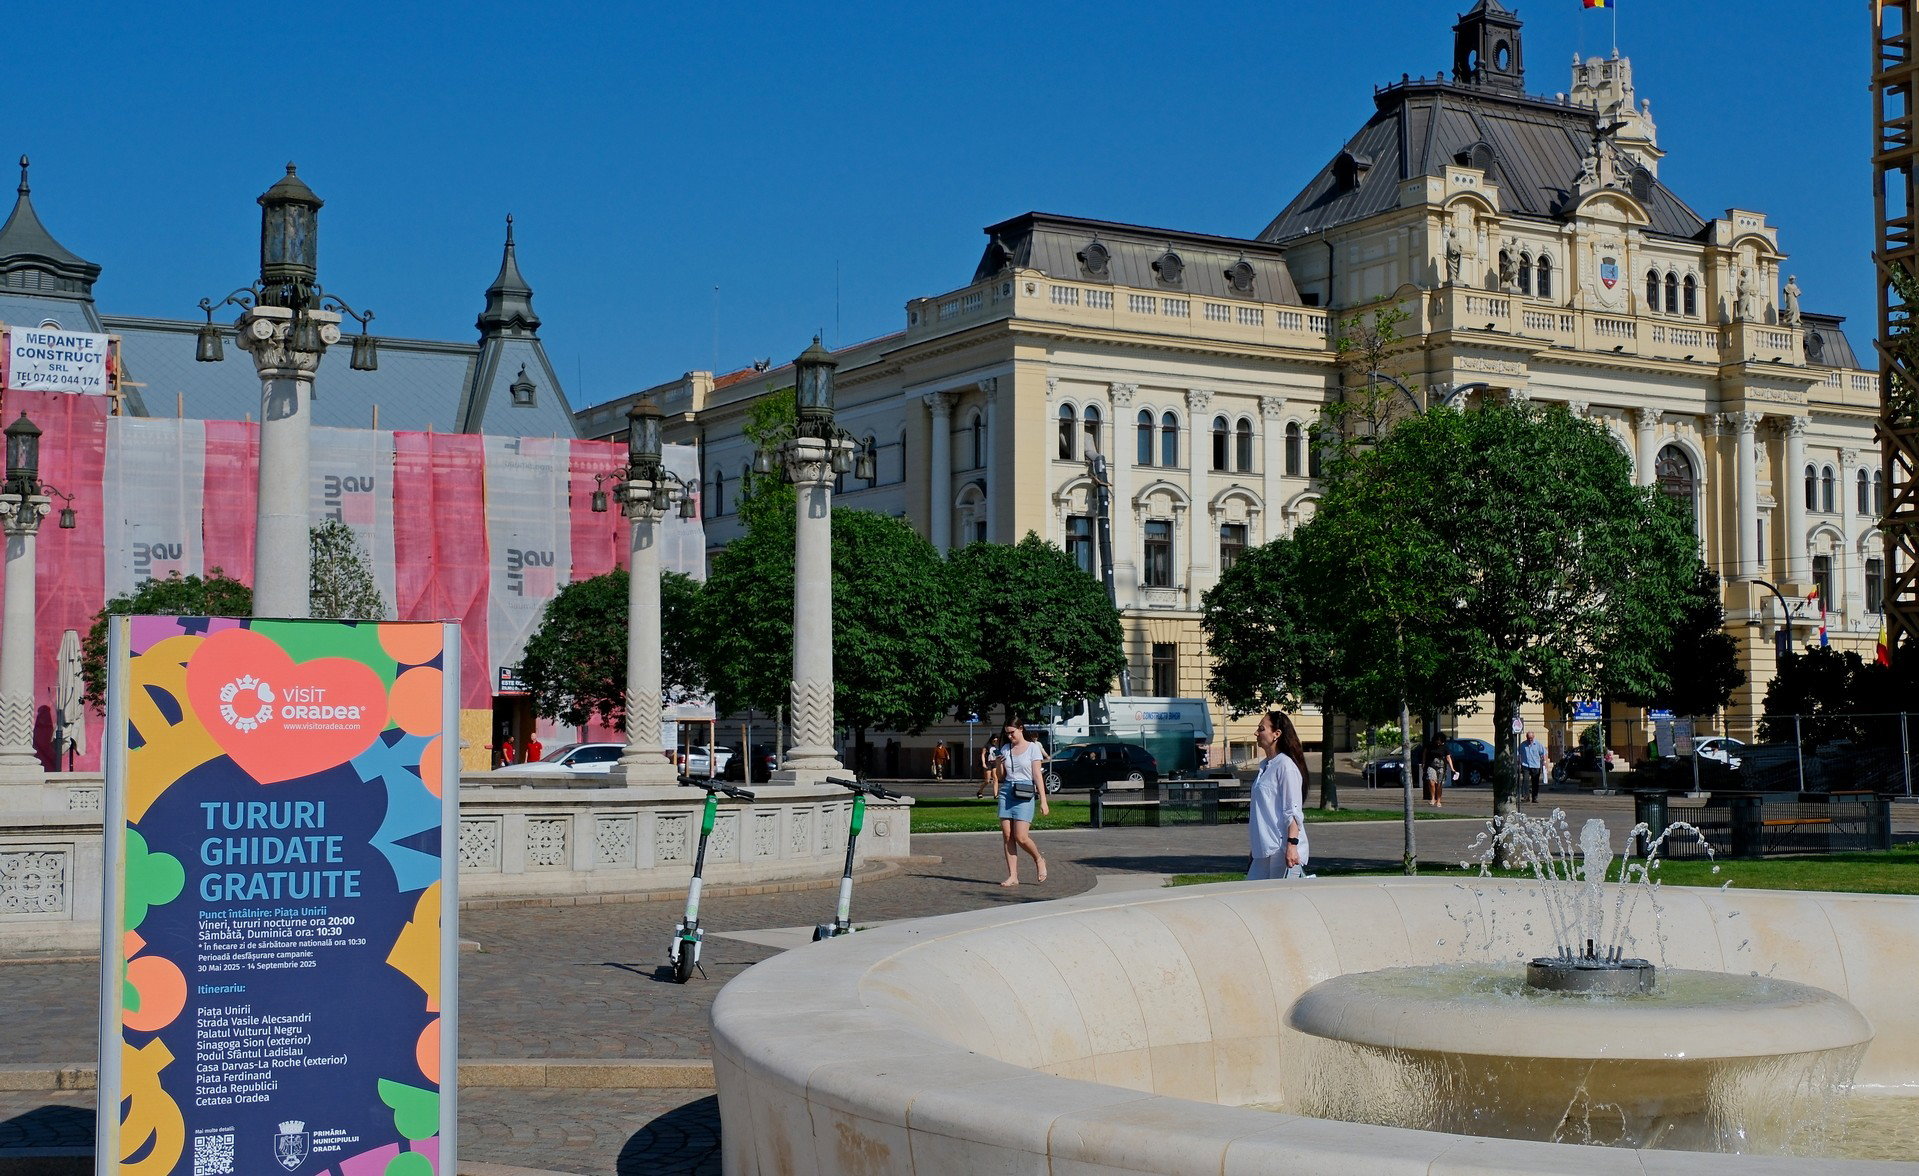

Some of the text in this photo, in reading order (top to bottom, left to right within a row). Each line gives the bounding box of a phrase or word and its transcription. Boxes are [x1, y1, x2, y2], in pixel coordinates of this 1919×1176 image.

[27, 333, 93, 348] MEDANTE
[16, 347, 102, 364] CONSTRUCT
[49, 363, 68, 372] SRL
[17, 372, 99, 386] TEL 0742 044 174
[200, 801, 325, 830] TURURI
[200, 836, 343, 866] GHIDATE
[200, 870, 361, 902] GRATUITE
[200, 906, 327, 919] Punct întâlnire: Piața Unirii
[199, 917, 355, 930] Vineri, tururi nocturne ora 20:00
[199, 927, 342, 940] Sâmbătă, Duminică ora: 10:30
[199, 950, 313, 961] Perioadă desfășurare campanie:
[257, 961, 298, 970] Septembrie
[198, 983, 246, 994] Itinerariu:
[198, 1005, 250, 1018] Piața Unirii
[197, 1013, 311, 1028] Strada Vasile Alecsandri
[198, 1026, 302, 1038] Palatul Vulturul Negru
[197, 1034, 311, 1051] Sinagoga Sion (exterior)
[197, 1047, 303, 1061] Podul Sfântul Ladislau
[197, 1054, 347, 1072] Casa Darvas-La Roche (exterior)
[224, 1070, 271, 1082] Ferdinand
[196, 1081, 277, 1095] Strada Republicii
[196, 1093, 270, 1106] Cetatea Oradea
[313, 1136, 359, 1144] MUNICIPIULUI
